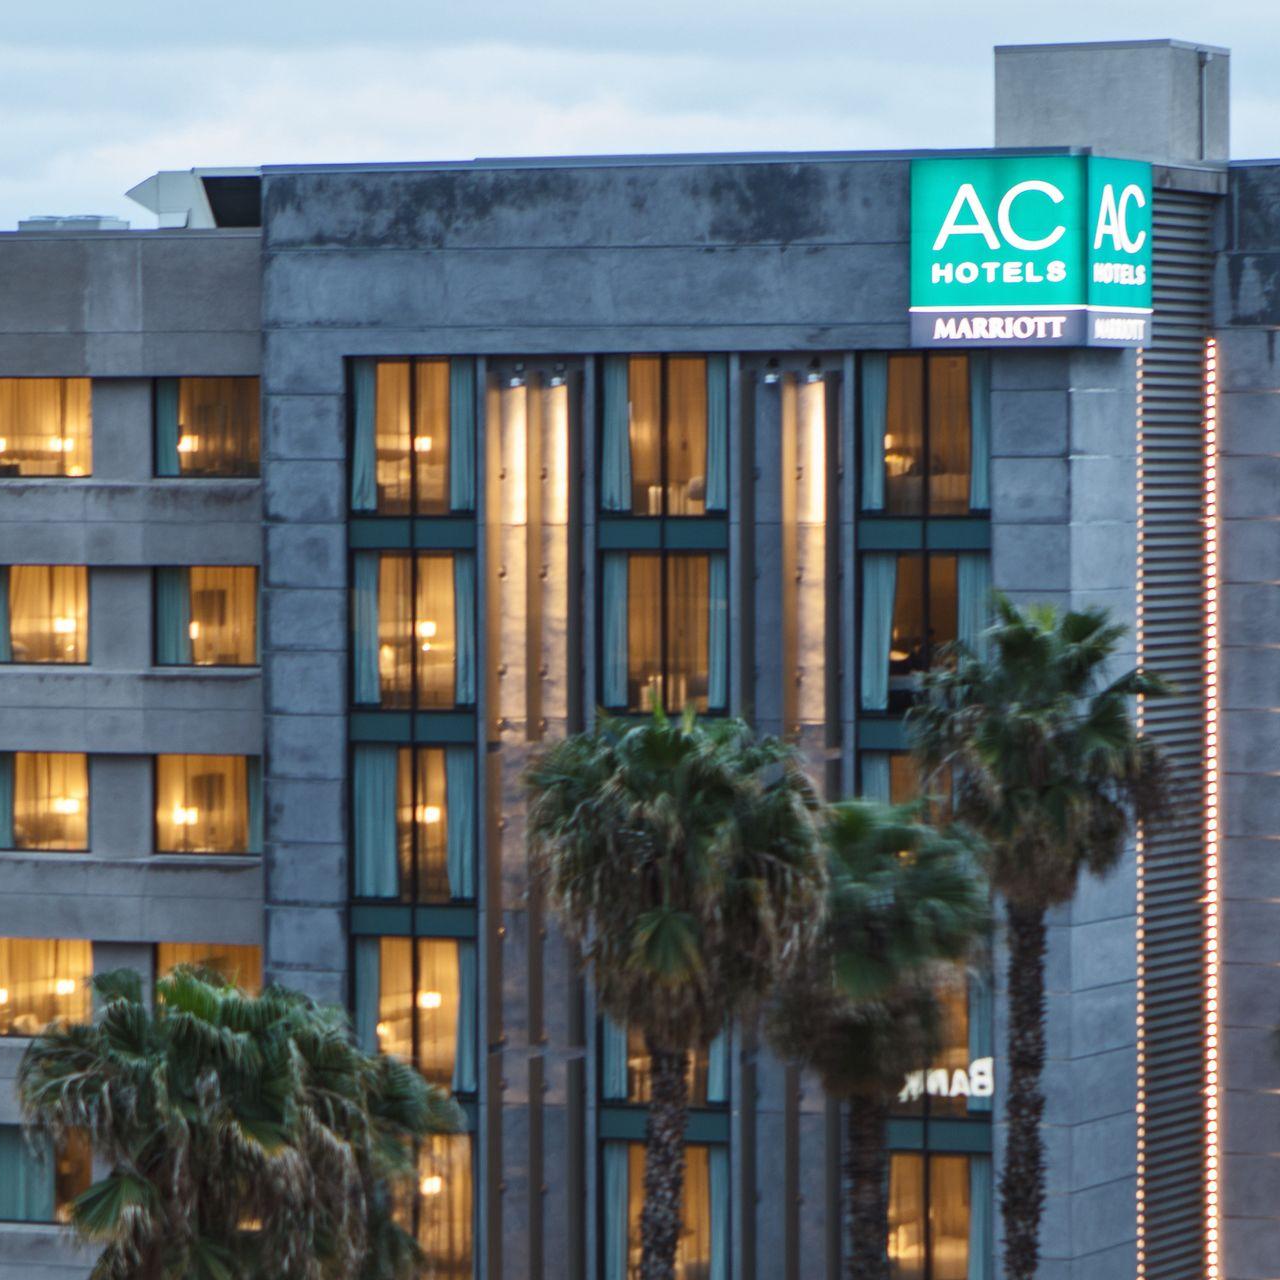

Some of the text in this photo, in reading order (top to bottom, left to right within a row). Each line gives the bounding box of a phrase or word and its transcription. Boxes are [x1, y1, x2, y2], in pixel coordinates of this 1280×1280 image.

[932, 180, 1066, 250] AC
[1093, 184, 1147, 254] AC
[931, 260, 1067, 284] HOTELS
[1093, 262, 1146, 286] HOTELS
[932, 316, 1067, 339] MARRIOTT
